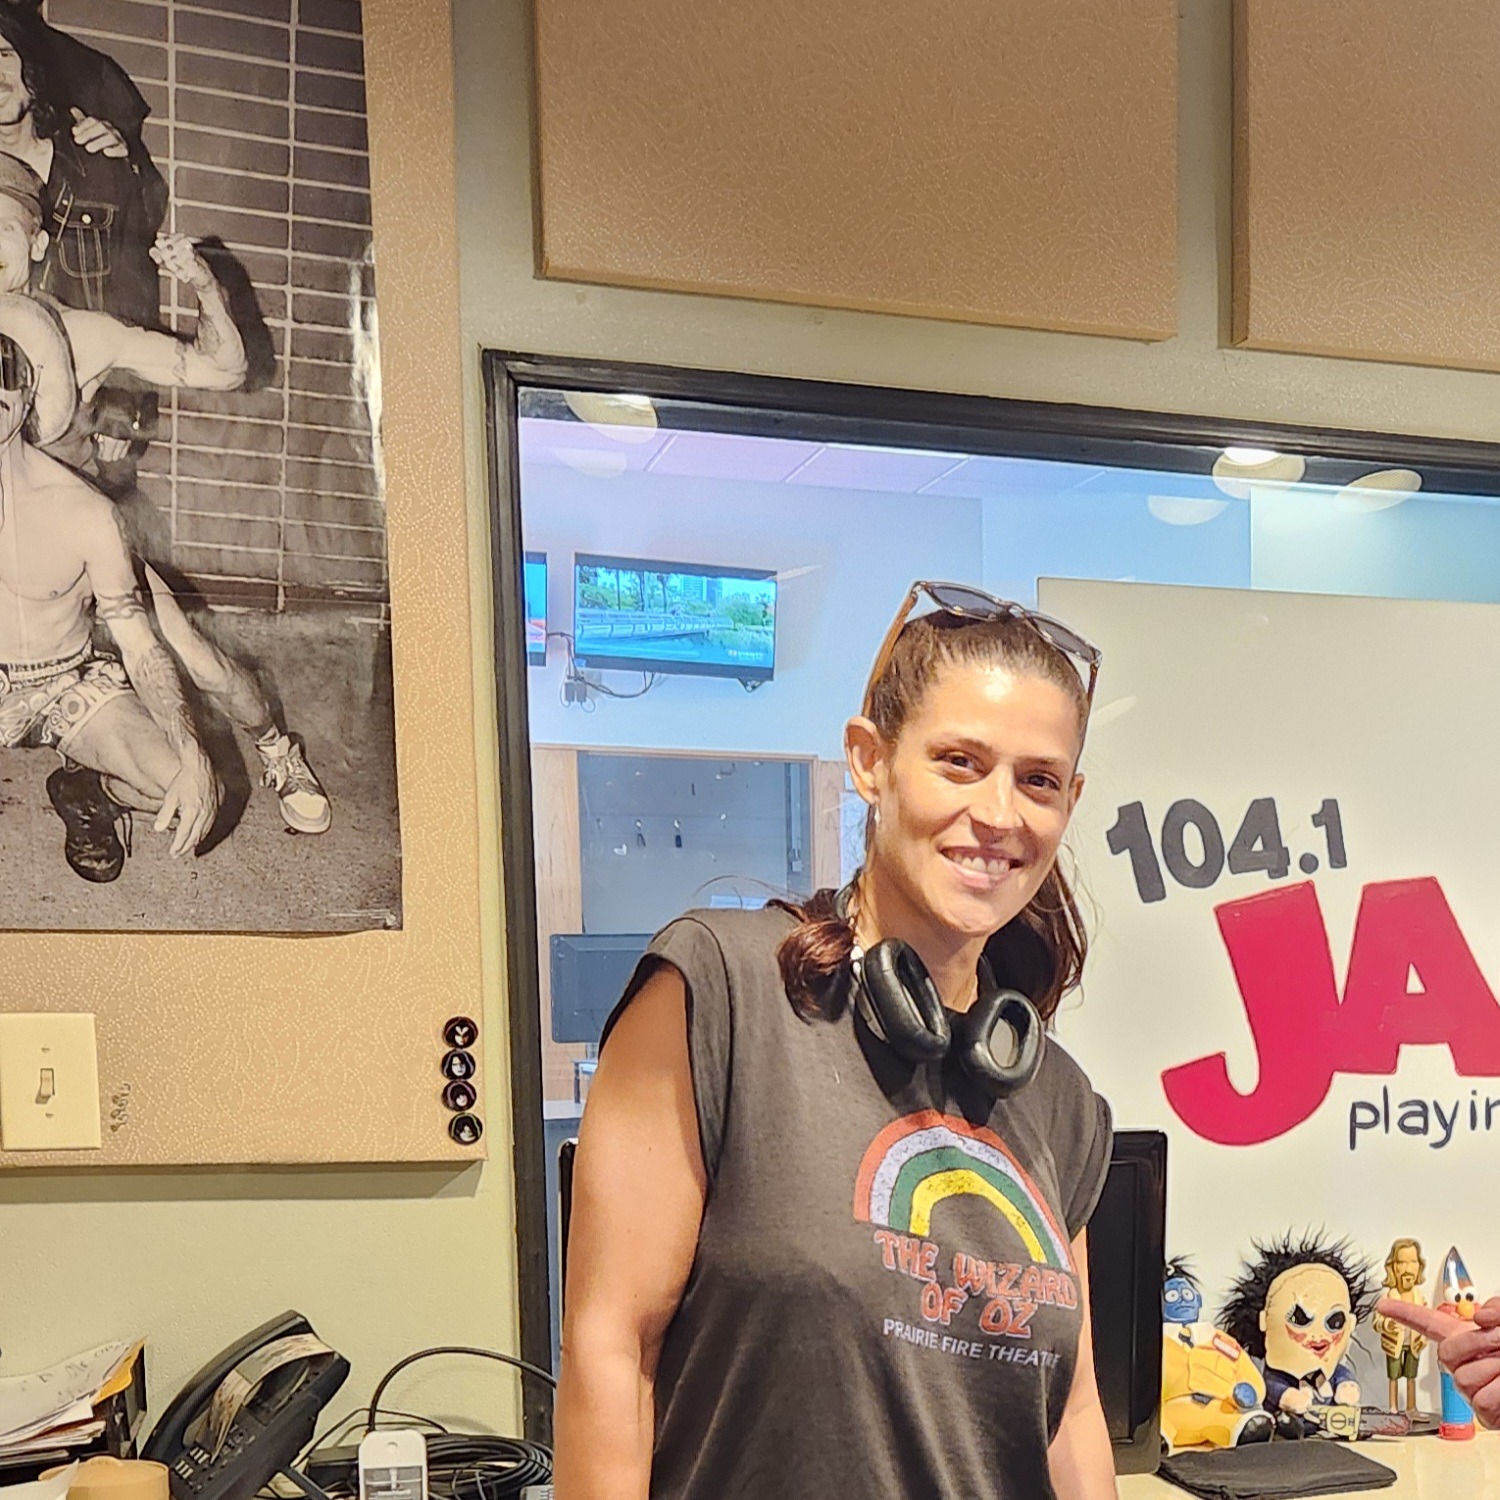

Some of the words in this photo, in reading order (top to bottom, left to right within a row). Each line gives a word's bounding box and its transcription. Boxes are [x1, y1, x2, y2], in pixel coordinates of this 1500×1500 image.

[1106, 797, 1348, 904] 104.1
[873, 1229, 940, 1283] THE
[953, 1252, 1078, 1310] WIZARD
[883, 1318, 939, 1349] PRAIRIE
[941, 1335, 984, 1359] FIRE
[920, 1282, 969, 1325] OF
[978, 1296, 1040, 1338] OZ
